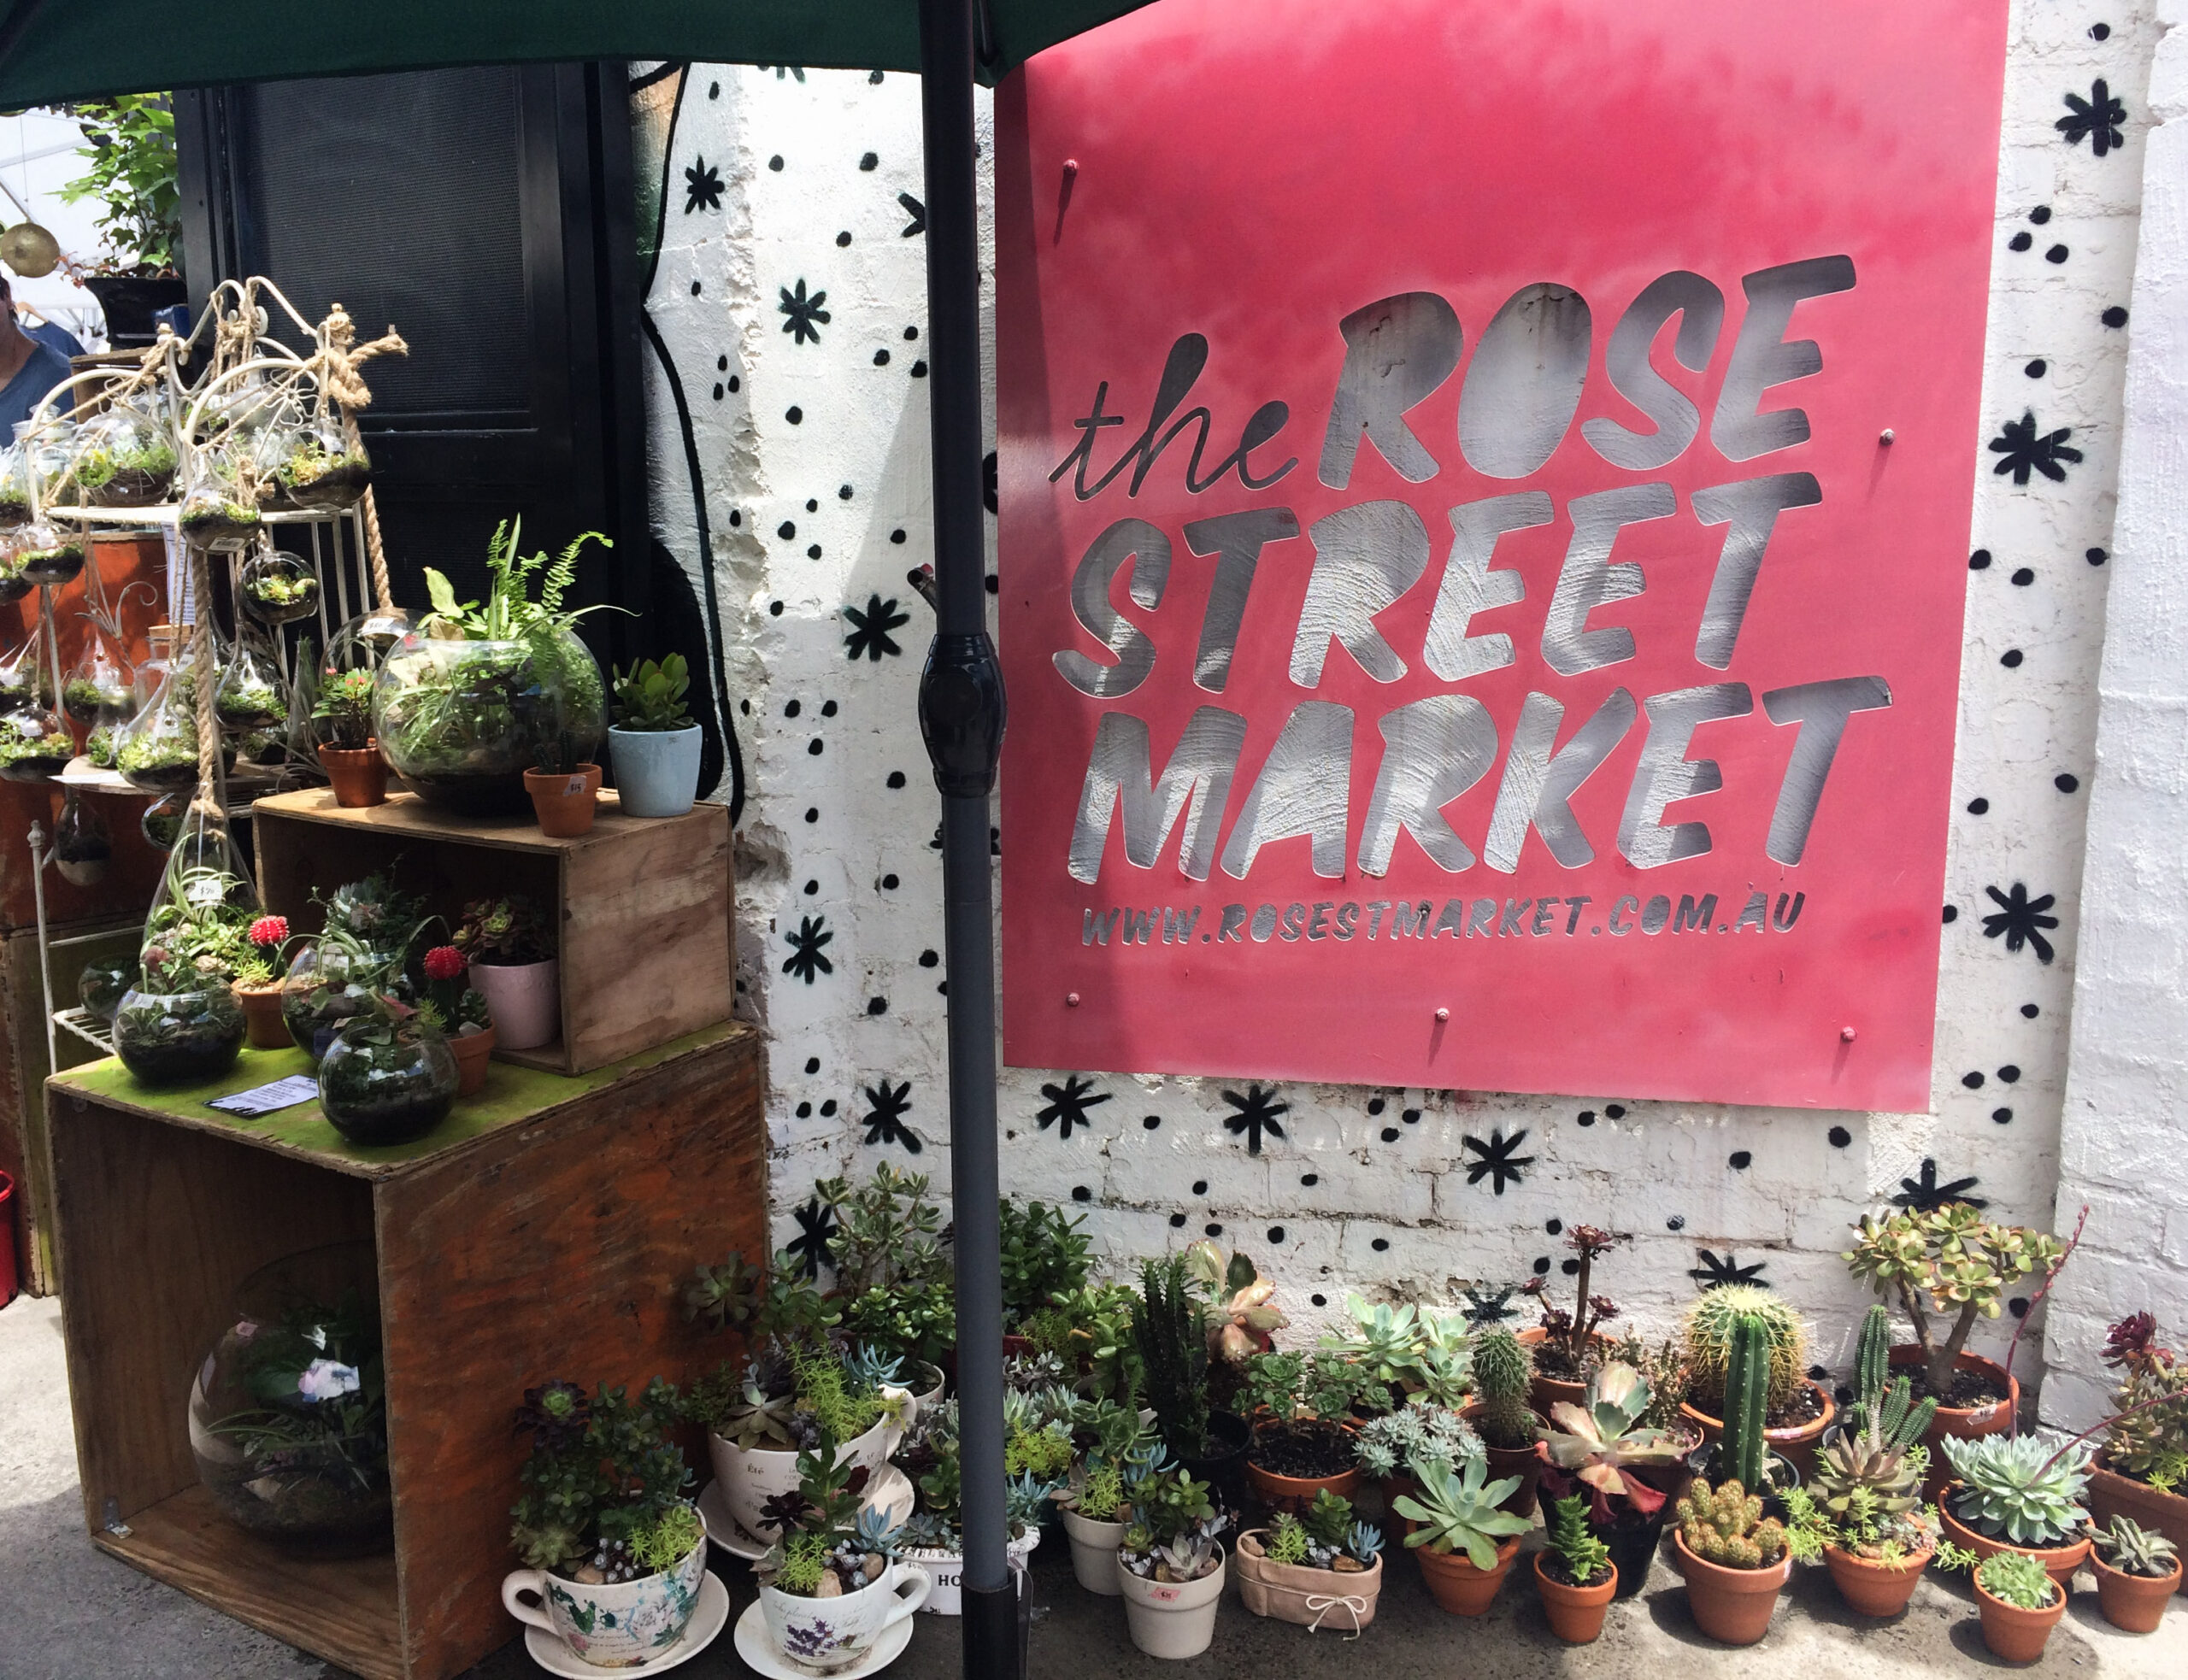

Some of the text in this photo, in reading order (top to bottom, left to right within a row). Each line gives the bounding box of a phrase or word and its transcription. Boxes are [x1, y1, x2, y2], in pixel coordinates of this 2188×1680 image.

[1049, 255, 1856, 501] the ROSE
[1052, 472, 1822, 699] STREET
[1068, 675, 1893, 885] MARKET
[1080, 891, 1806, 948] WWW.ROSESTMARKET.COM.AU
